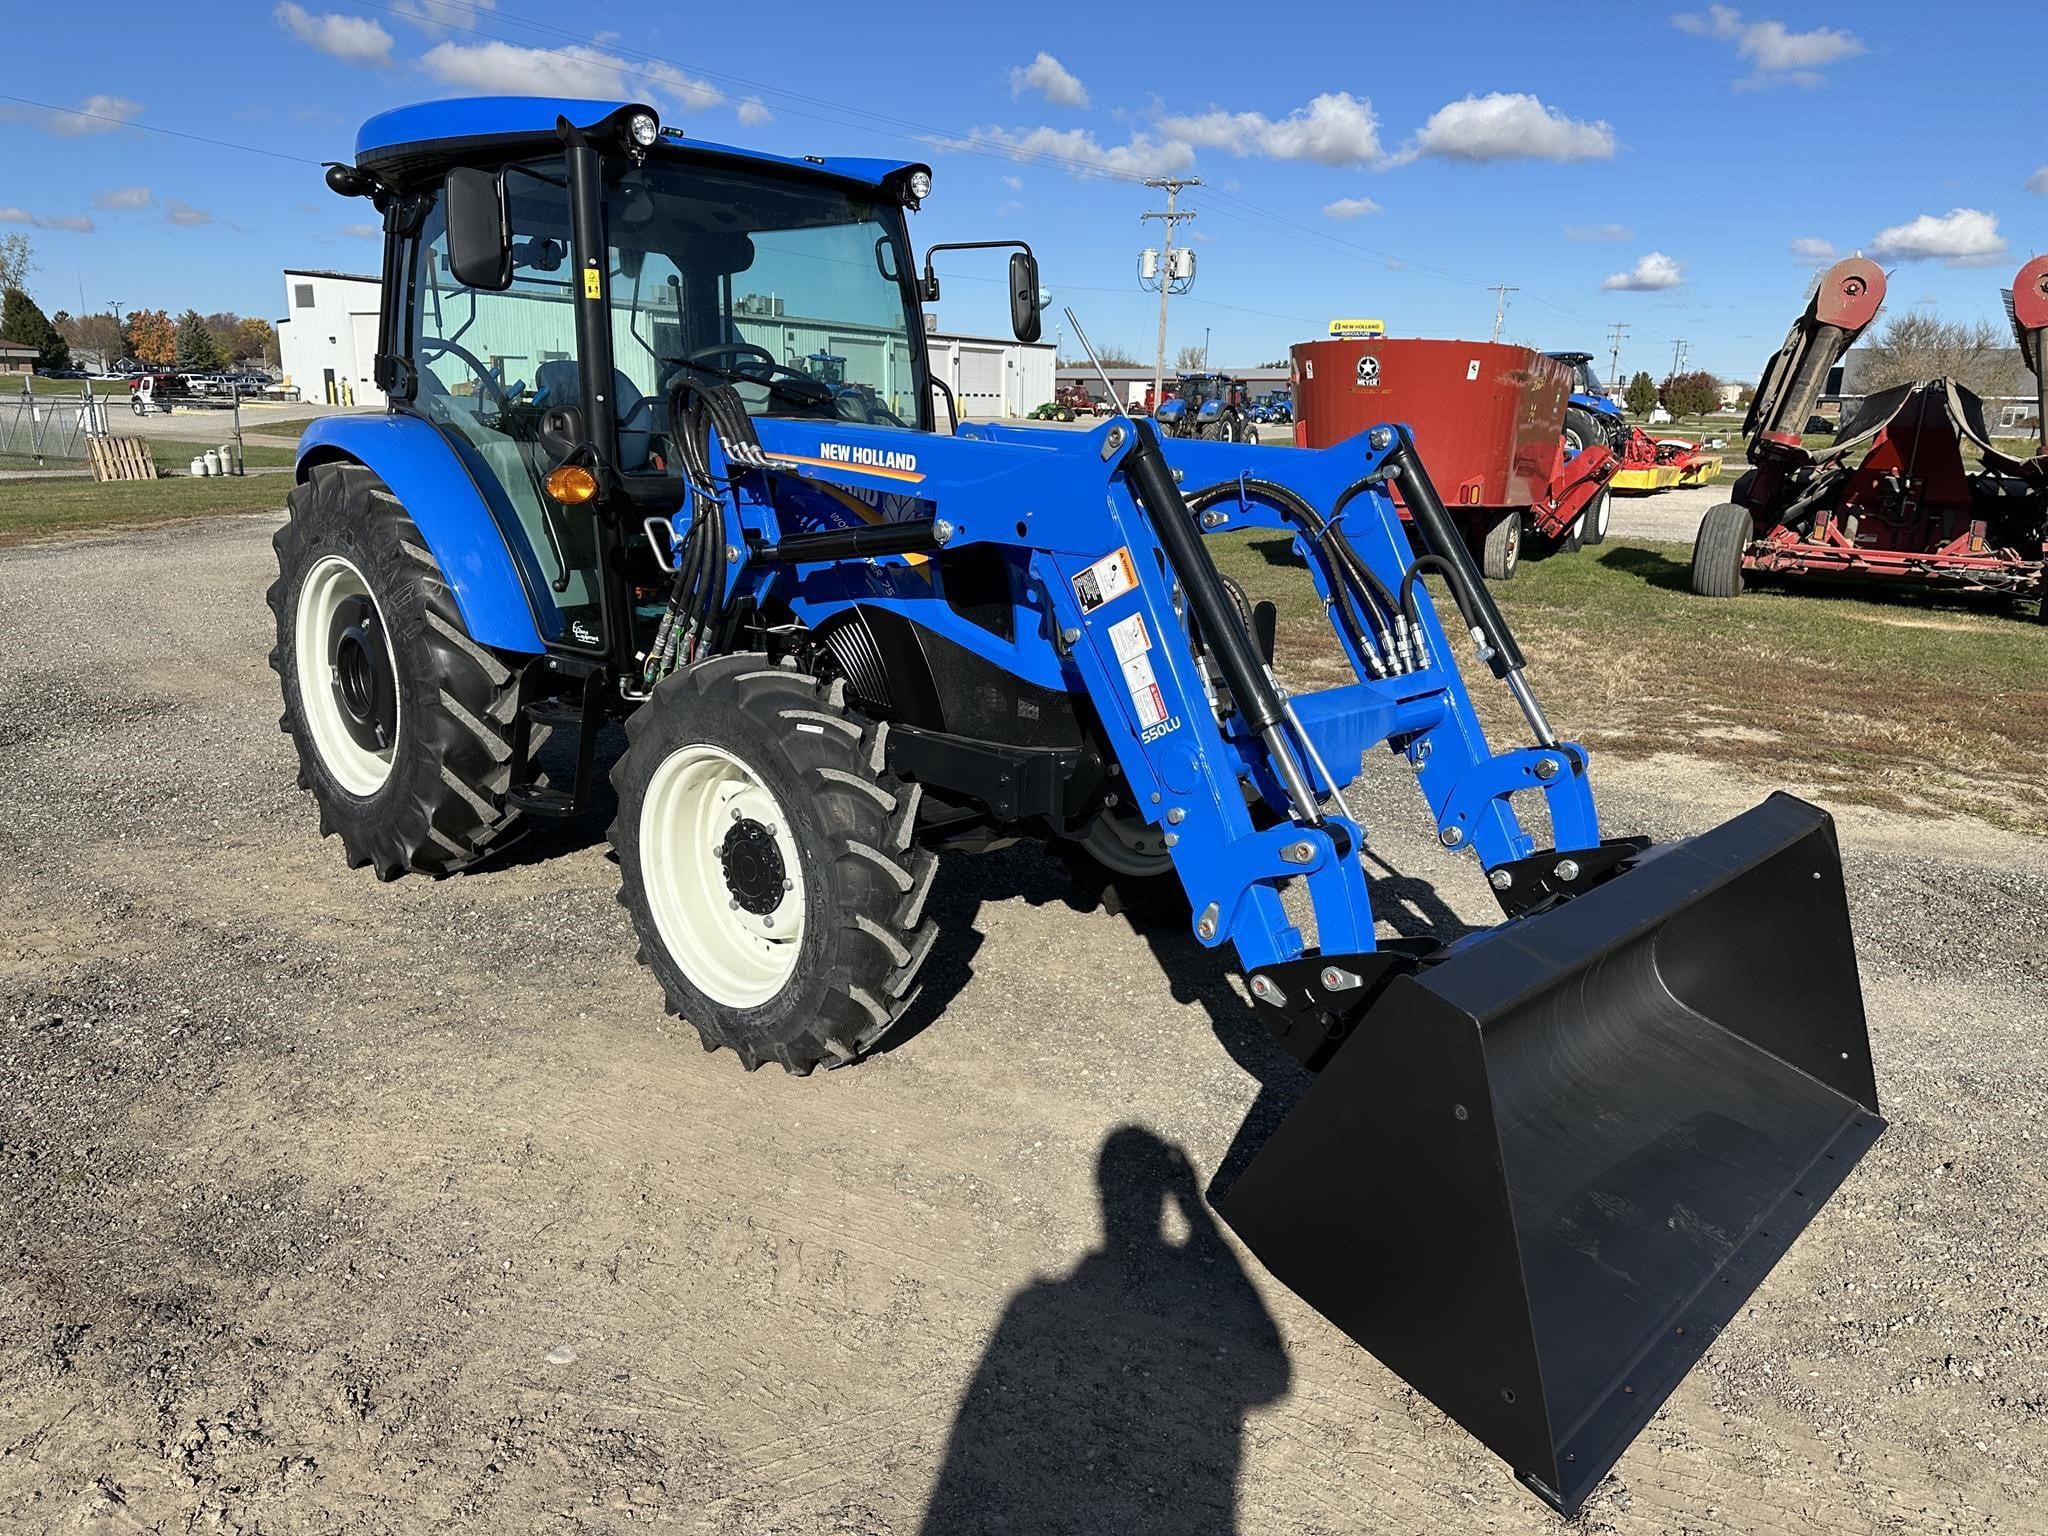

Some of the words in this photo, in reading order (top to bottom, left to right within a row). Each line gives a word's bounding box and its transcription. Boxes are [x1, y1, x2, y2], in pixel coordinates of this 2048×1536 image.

[820, 442, 850, 462] NEW
[852, 446, 917, 472] HOLLAND
[881, 580, 895, 596] 75
[1141, 716, 1181, 744] 550LU
